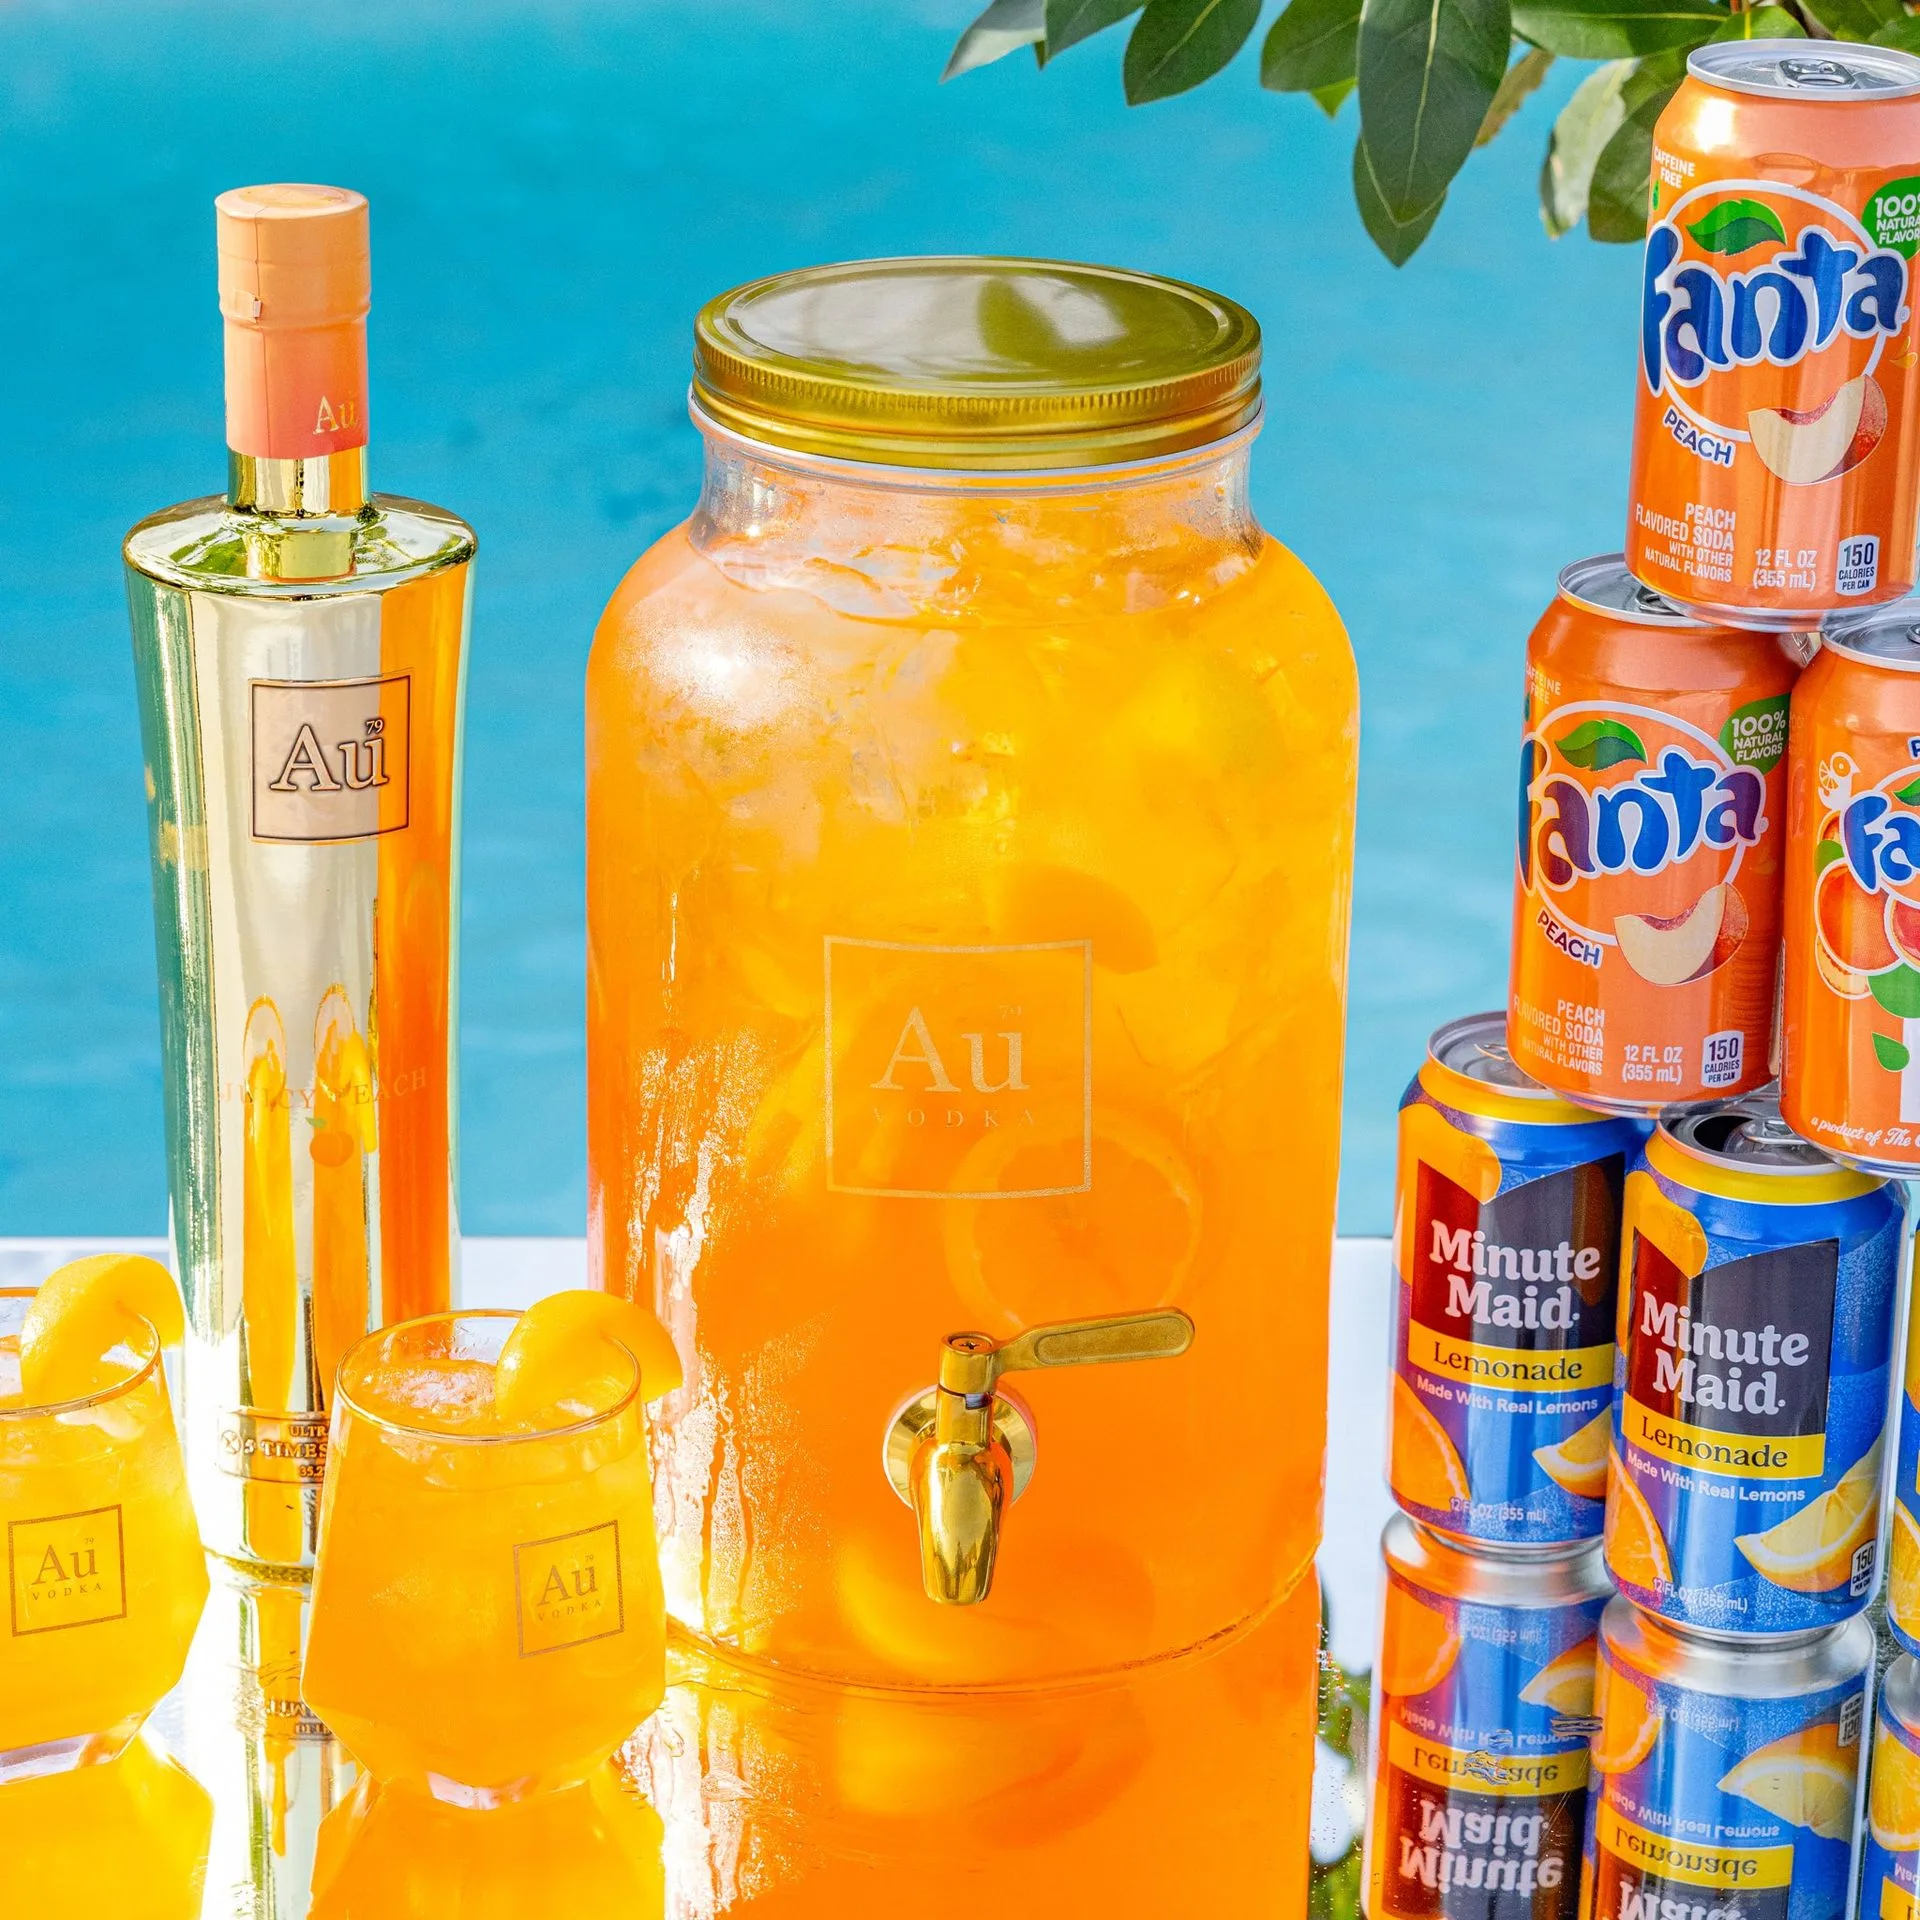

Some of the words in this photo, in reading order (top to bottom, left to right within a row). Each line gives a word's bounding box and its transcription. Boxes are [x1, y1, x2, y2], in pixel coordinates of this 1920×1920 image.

[1654, 146, 1696, 177] CAFFEINE
[1660, 166, 1684, 189] FREE
[1875, 194, 1920, 218] 100
[1876, 215, 1920, 232] NATURA
[1879, 228, 1920, 245] FLAVOR
[313, 396, 357, 435] Au
[1663, 407, 1734, 466] PEACH
[1635, 503, 1689, 542] FLAVORED
[1692, 525, 1735, 552] SODA
[1685, 502, 1736, 531] PEACH
[1644, 546, 1682, 572] NATURAL
[1683, 560, 1733, 583] FLAVORS
[1669, 540, 1695, 560] WITH
[1696, 547, 1734, 567] OTHER
[1755, 548, 1772, 567] 12
[1775, 549, 1793, 568] FL
[1796, 550, 1818, 569] OZ
[1843, 542, 1875, 568] 150
[1753, 568, 1786, 590] (355
[1789, 569, 1817, 592] mL)
[1838, 566, 1875, 581] CALORIES
[1842, 581, 1856, 591] PER
[1857, 579, 1871, 589] CAN
[366, 719, 384, 735] 79
[1731, 709, 1786, 738] 100%
[1733, 730, 1784, 751] NATURAL
[1736, 742, 1783, 762] FLAVORS
[269, 723, 390, 792] Au
[1537, 908, 1602, 966] PEACH
[1513, 993, 1561, 1036] FLAVORED
[1565, 1021, 1605, 1048] SODA
[1557, 999, 1605, 1028] PEACH
[869, 1006, 1031, 1093] Au
[1522, 1035, 1555, 1064] NATURAL
[1556, 1053, 1603, 1076] FLAVORS
[1543, 1033, 1566, 1052] WITH
[1568, 1042, 1604, 1061] OTHER
[1623, 1044, 1640, 1062] 12
[1642, 1045, 1660, 1063] FL
[1663, 1046, 1684, 1064] OZ
[1708, 1037, 1739, 1062] 150
[1621, 1062, 1653, 1084] (355
[1656, 1064, 1683, 1085] mL)
[1704, 1059, 1740, 1074] CALORIES
[1708, 1074, 1721, 1083] PER
[1722, 1071, 1736, 1081] CAN
[872, 1108, 1036, 1128] VODKA
[1810, 1116, 1819, 1126] a
[1817, 1119, 1865, 1140] product
[1864, 1129, 1883, 1147] of
[1883, 1127, 1912, 1147] The
[1428, 1218, 1601, 1283] Minute
[1640, 1290, 1810, 1368] Minute
[1434, 1342, 1583, 1381] Lemonade
[1416, 1374, 1453, 1401] Made
[1455, 1389, 1493, 1411] With
[1496, 1398, 1533, 1414] Real
[1536, 1399, 1598, 1415] Lemons
[289, 1423, 328, 1438] ULTR
[1641, 1416, 1789, 1468] Lemonade
[243, 1438, 257, 1455] 5
[260, 1440, 329, 1459] TIMES
[298, 1465, 325, 1478] 35.2
[1627, 1448, 1658, 1478] Made
[1660, 1467, 1695, 1492] With
[1699, 1480, 1735, 1500] Real
[1739, 1487, 1806, 1502] Lemons
[31, 1544, 99, 1586] Au
[1855, 1544, 1874, 1572] 150
[32, 1582, 103, 1601] VODKA
[536, 1564, 599, 1607] Au
[537, 1599, 601, 1622] VODKA
[1726, 1597, 1748, 1614] mL)
